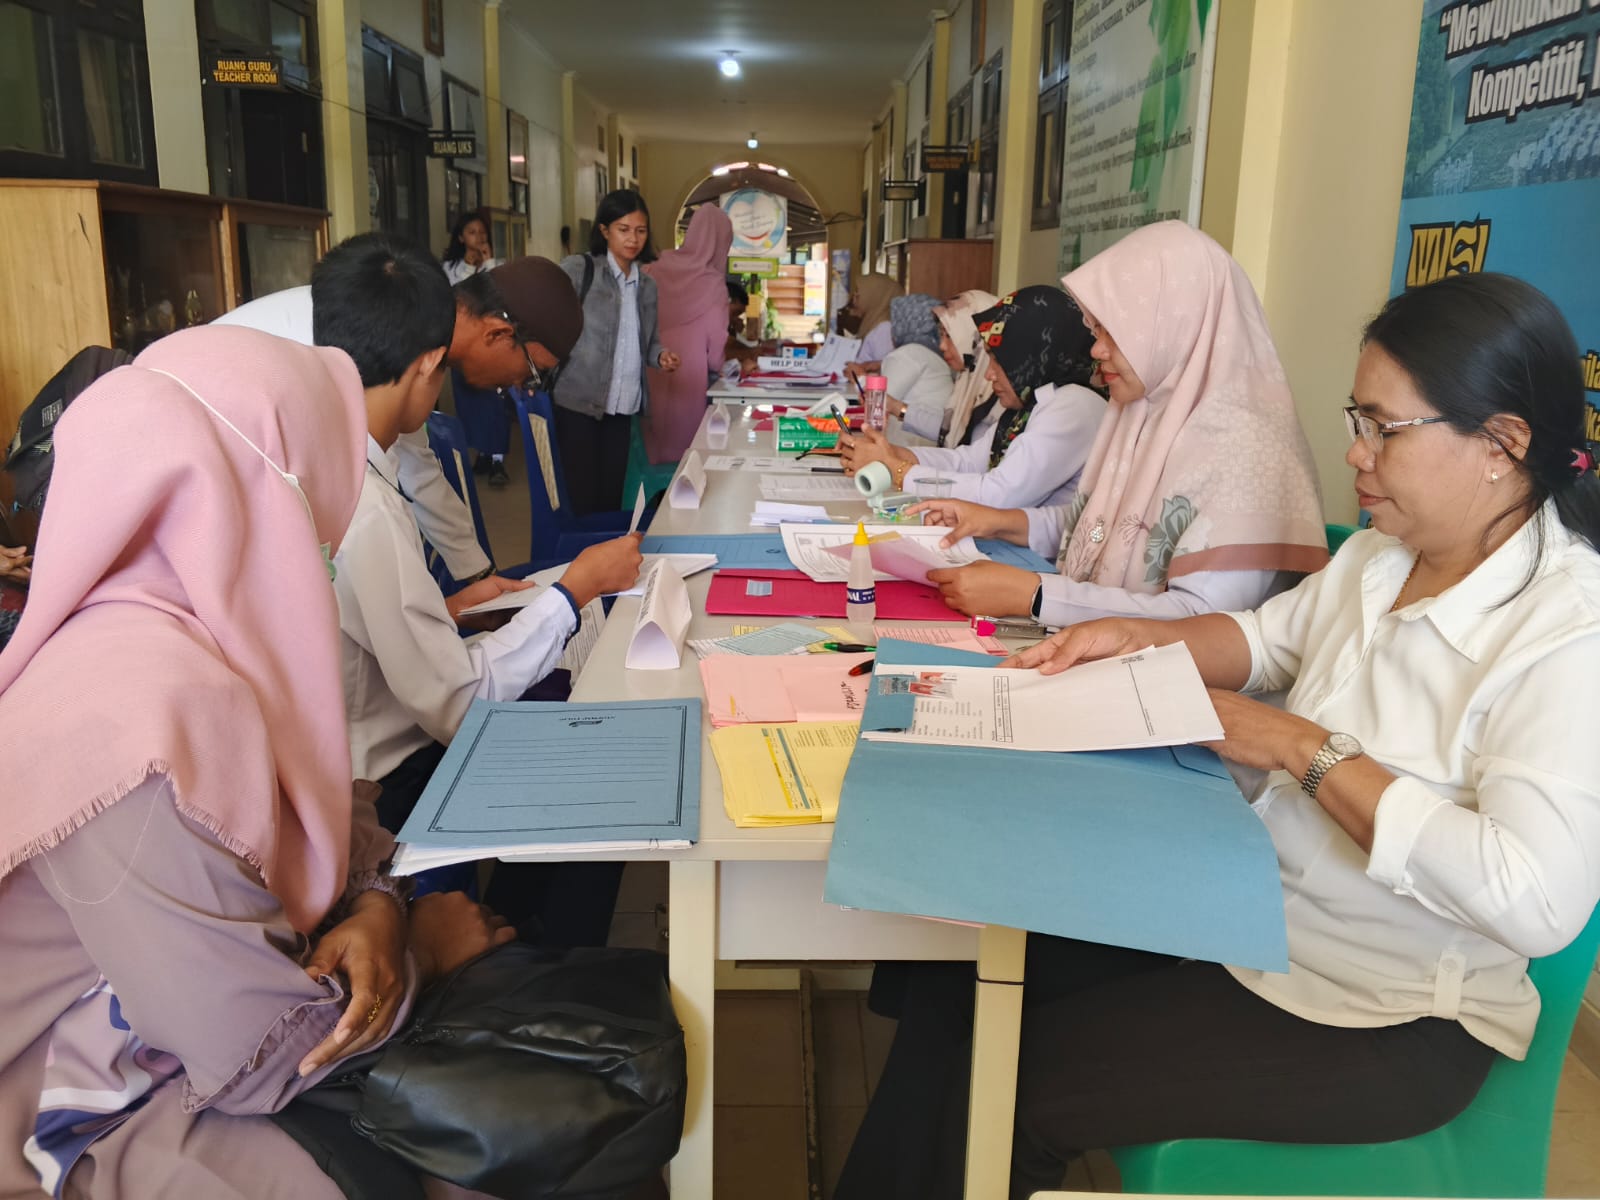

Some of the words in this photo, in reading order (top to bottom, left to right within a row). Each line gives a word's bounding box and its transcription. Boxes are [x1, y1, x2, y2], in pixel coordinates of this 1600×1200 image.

[217, 60, 246, 71] RUANG
[248, 61, 272, 72] GURU
[213, 71, 251, 82] TEACHER
[253, 72, 278, 84] ROOM
[1468, 40, 1586, 117] Kompetitif,
[433, 141, 456, 154] RUANG
